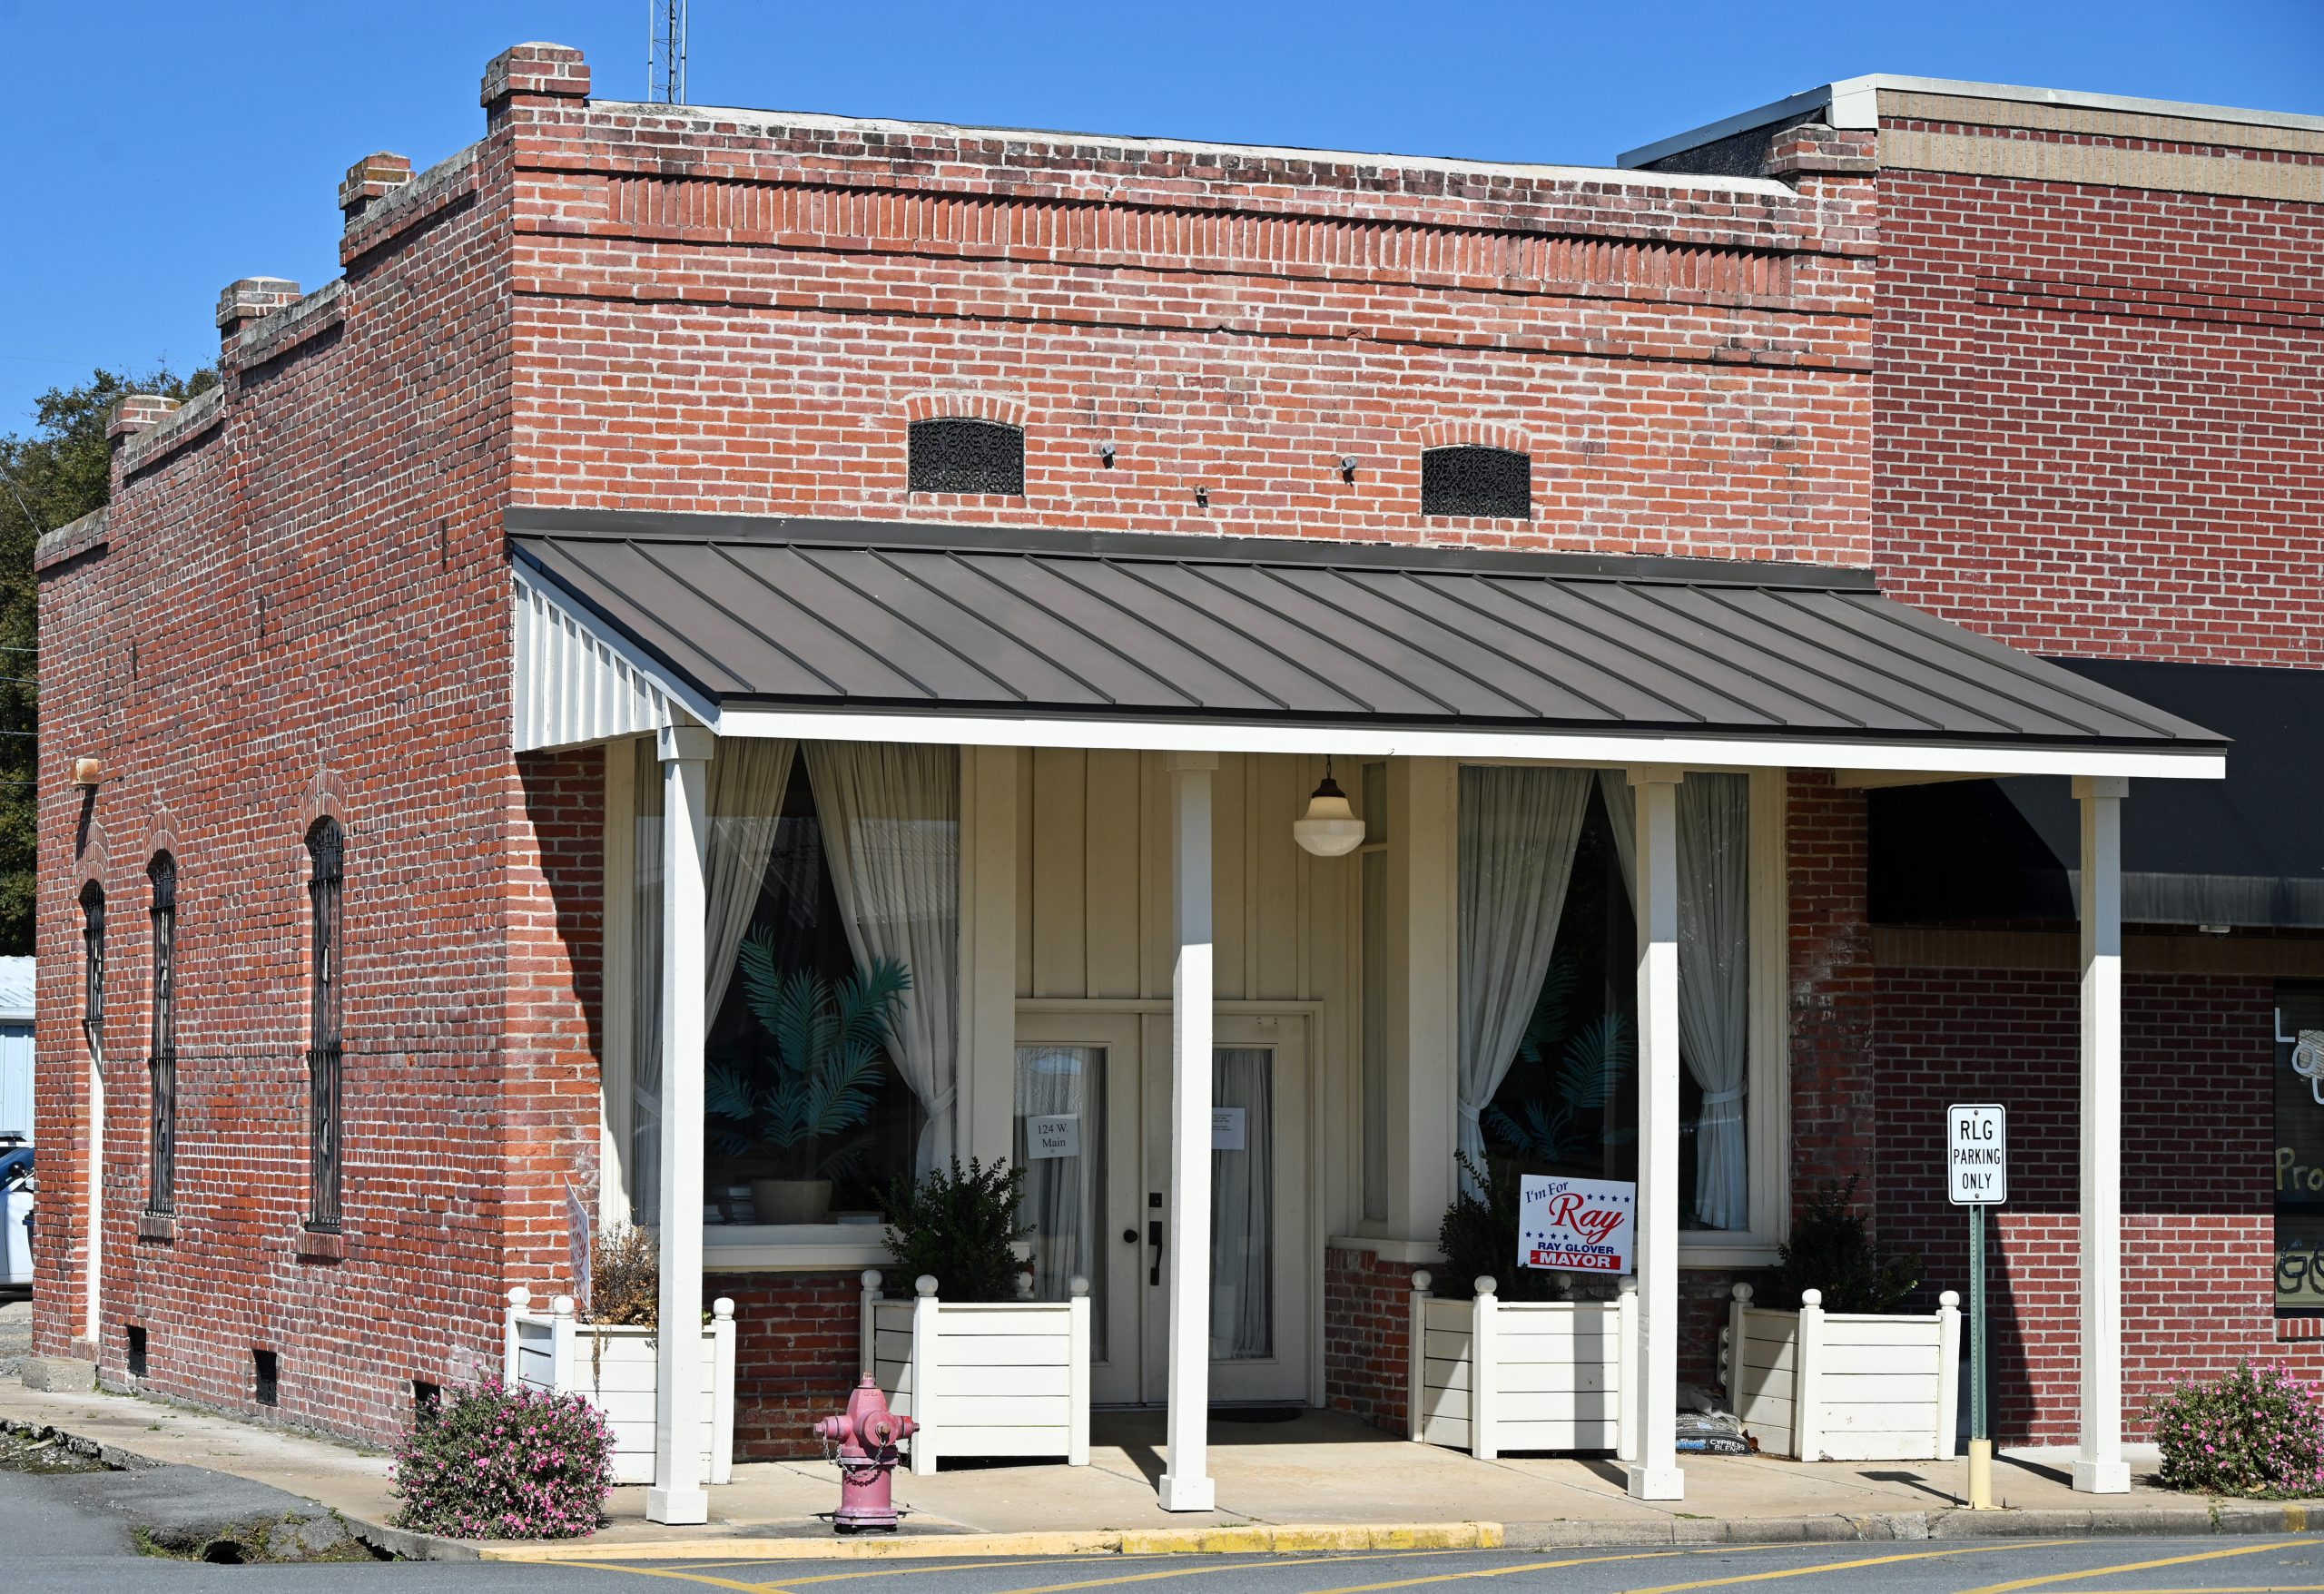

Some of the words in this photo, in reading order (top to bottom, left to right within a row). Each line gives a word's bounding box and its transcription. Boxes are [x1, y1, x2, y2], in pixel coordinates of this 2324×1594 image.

[1038, 1125, 1054, 1134] 124
[1057, 1123, 1068, 1133] W.
[1961, 1120, 1993, 1140] RLG
[1042, 1137, 1066, 1147] Main
[1954, 1148, 2001, 1165] PARKING
[1962, 1173, 1992, 1189] ONLY
[1525, 1189, 1546, 1203] I'm
[1548, 1181, 1569, 1196] For
[1549, 1193, 1624, 1245] Ray
[1538, 1242, 1561, 1251] RAY
[1565, 1244, 1614, 1255] GLOVER
[1539, 1252, 1610, 1268] MAYOR
[1709, 1439, 1745, 1451] CYPRESS
